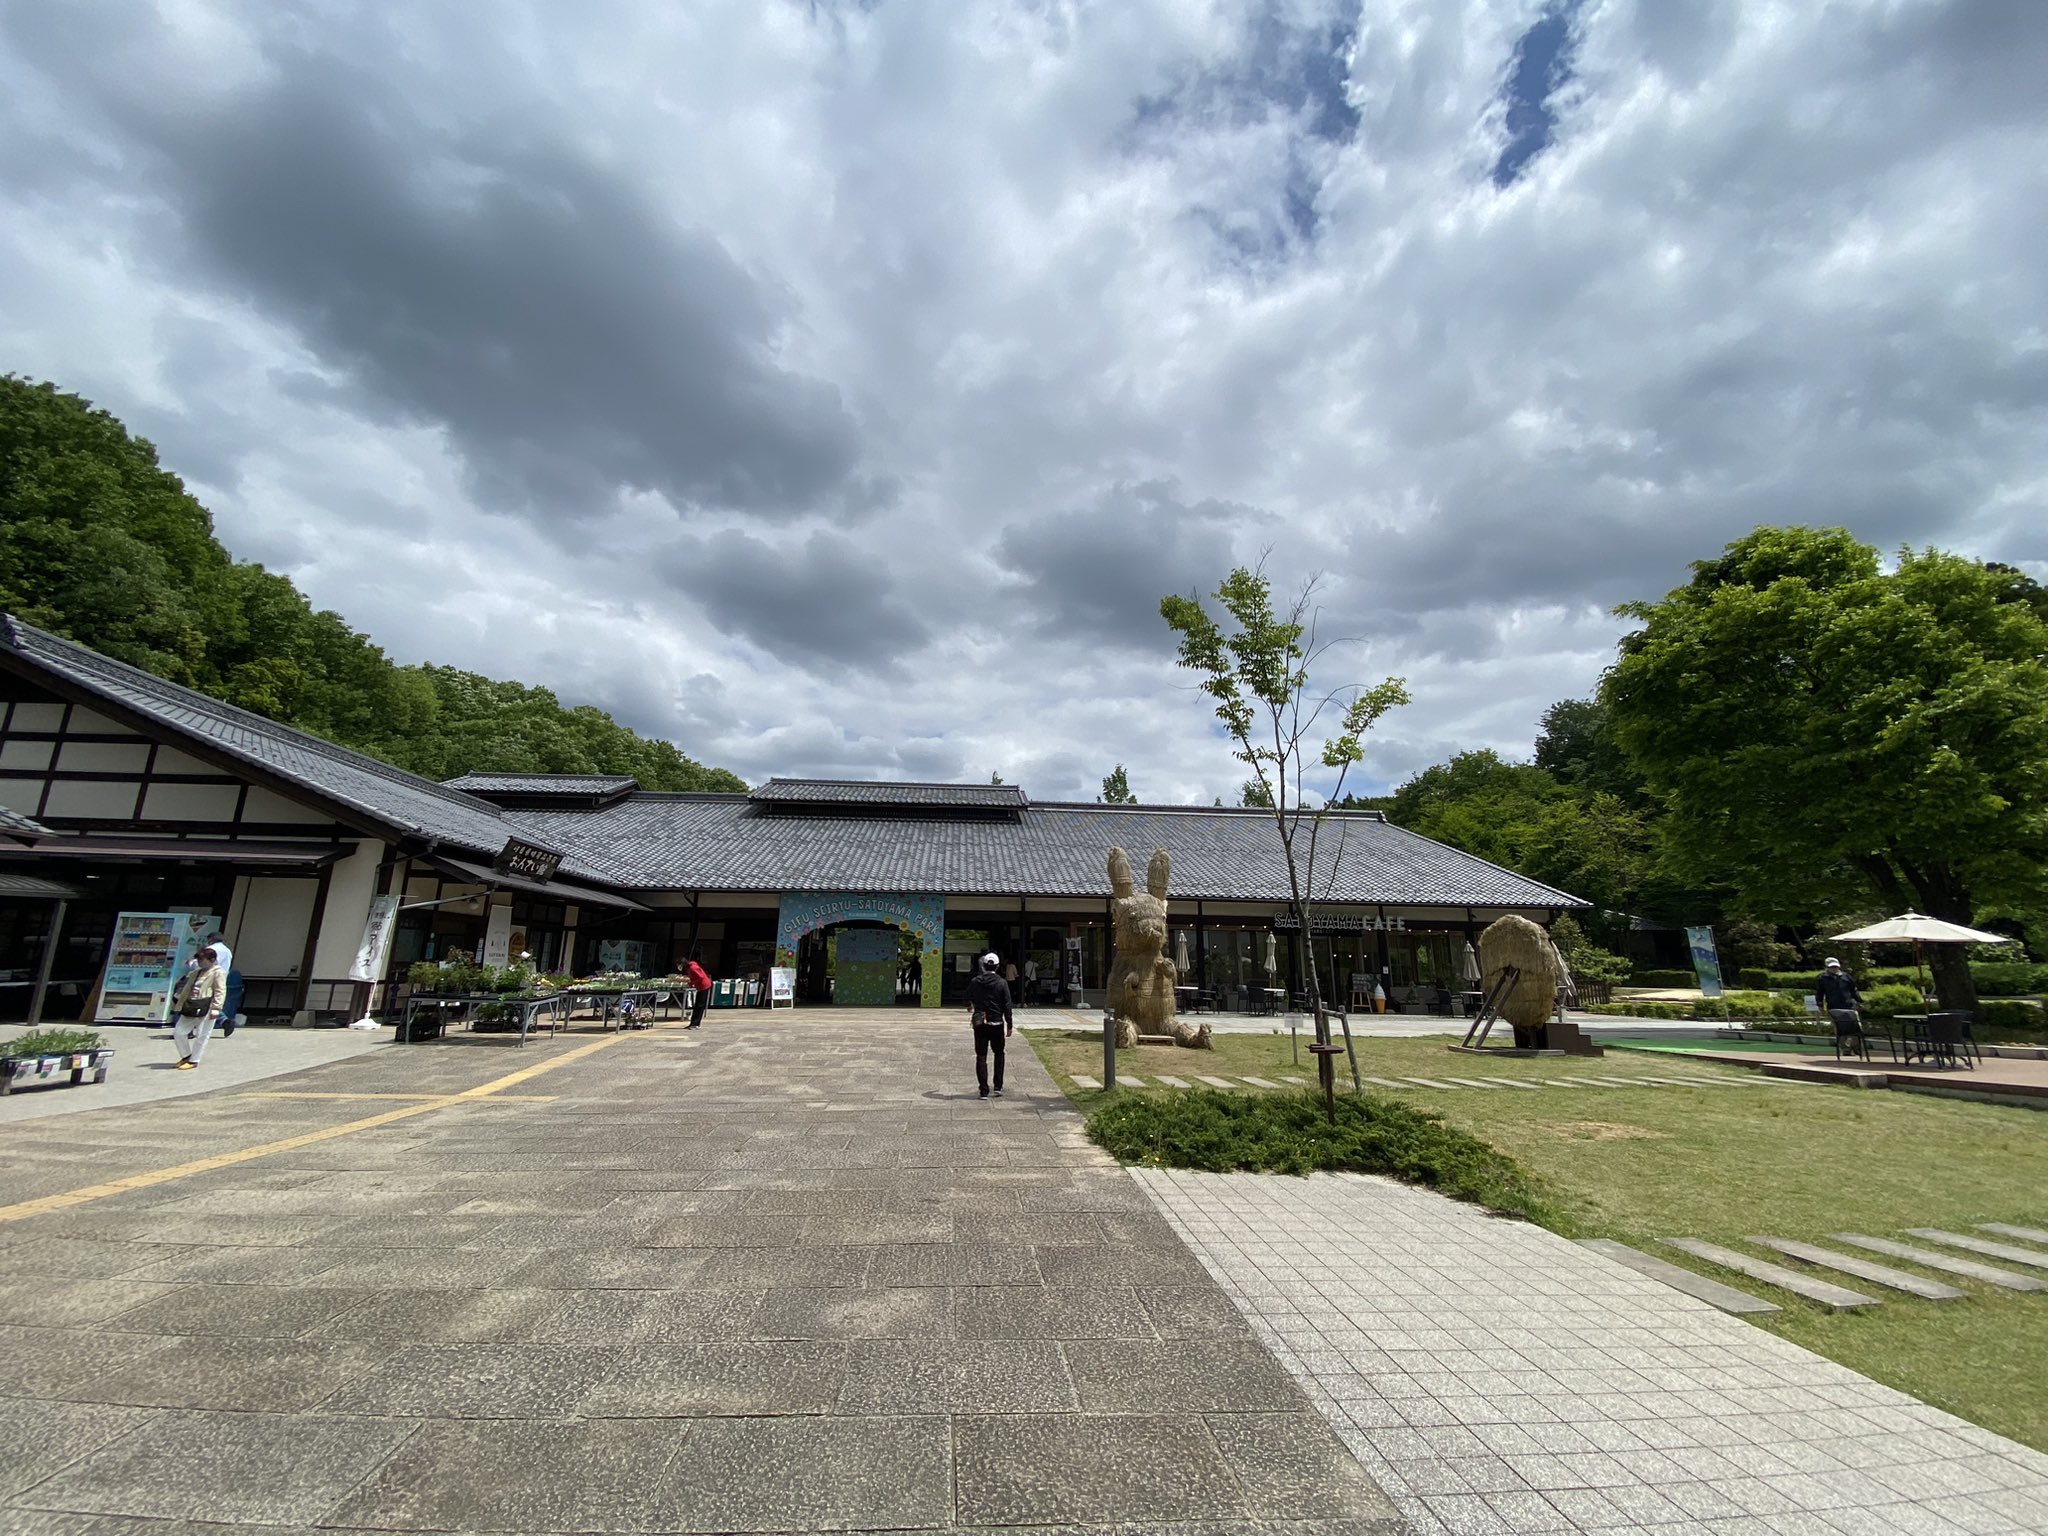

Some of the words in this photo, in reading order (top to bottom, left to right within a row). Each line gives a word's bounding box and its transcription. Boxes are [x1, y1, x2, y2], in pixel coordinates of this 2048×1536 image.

[784, 912, 811, 934] GIFU
[813, 899, 911, 919] SEIRYU-SATOYAMA
[914, 913, 940, 935] PARK
[1362, 914, 1406, 931] CAFE
